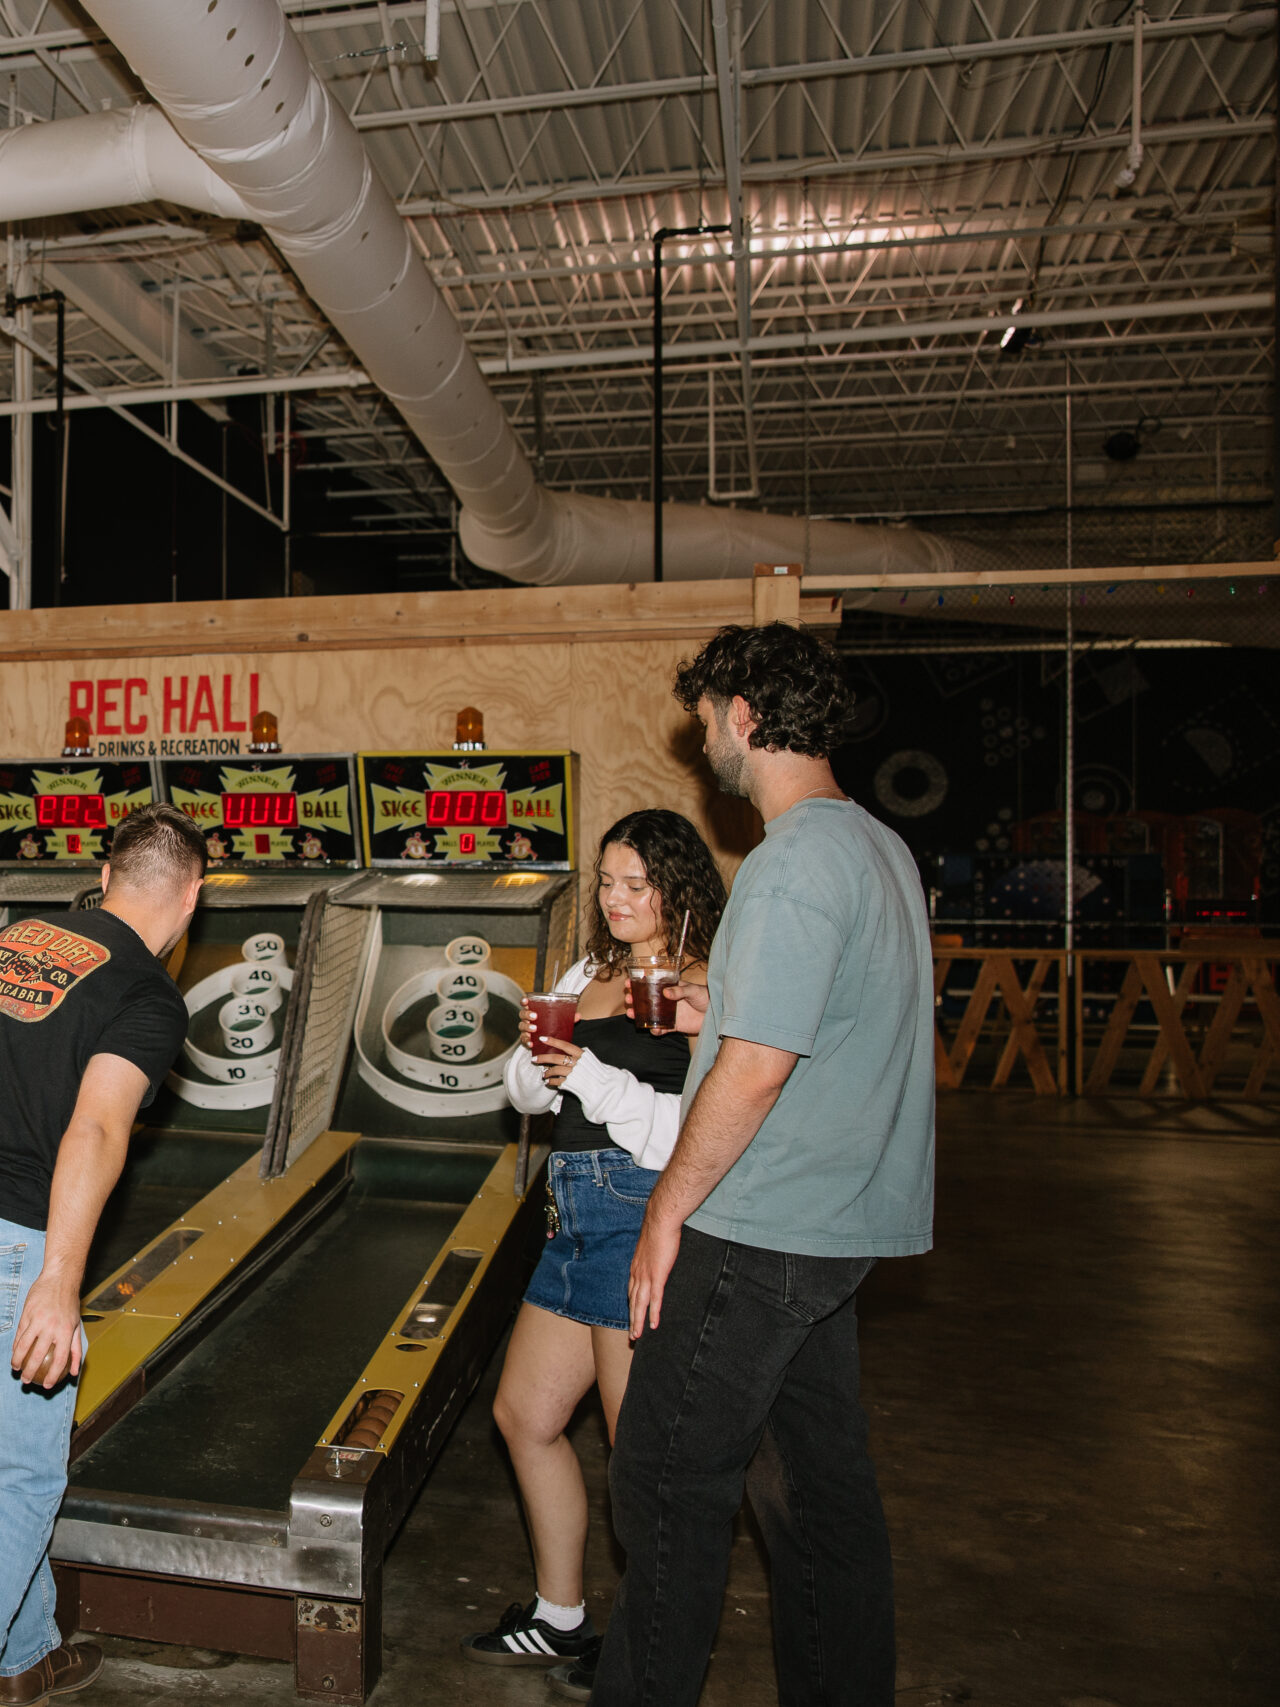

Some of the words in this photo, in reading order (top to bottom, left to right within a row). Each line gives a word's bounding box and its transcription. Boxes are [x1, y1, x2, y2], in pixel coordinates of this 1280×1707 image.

[70, 678, 148, 735] REC
[99, 740, 145, 756] DRINKS
[148, 741, 157, 755] &
[161, 739, 240, 755] RECREATION
[47, 778, 88, 791] WINNER
[236, 775, 279, 789] WINNER
[442, 772, 488, 786] WINNER
[181, 801, 219, 819] SKEE
[302, 801, 342, 818] BALL
[381, 800, 422, 817] SKEE
[513, 799, 555, 817] BALL
[428, 792, 504, 822] 000
[461, 834, 473, 852] 0
[2, 925, 52, 946] RED
[47, 935, 99, 967] DIRT
[254, 940, 278, 953] 50
[460, 944, 483, 956] 50
[50, 970, 67, 985] CO.
[249, 970, 272, 982] 40
[452, 975, 477, 987] 40
[238, 1004, 266, 1017] 30
[445, 1009, 474, 1022] 30
[231, 1037, 254, 1049] 20
[440, 1043, 467, 1056] 20
[227, 1067, 246, 1080] 10
[439, 1073, 459, 1088] 10
